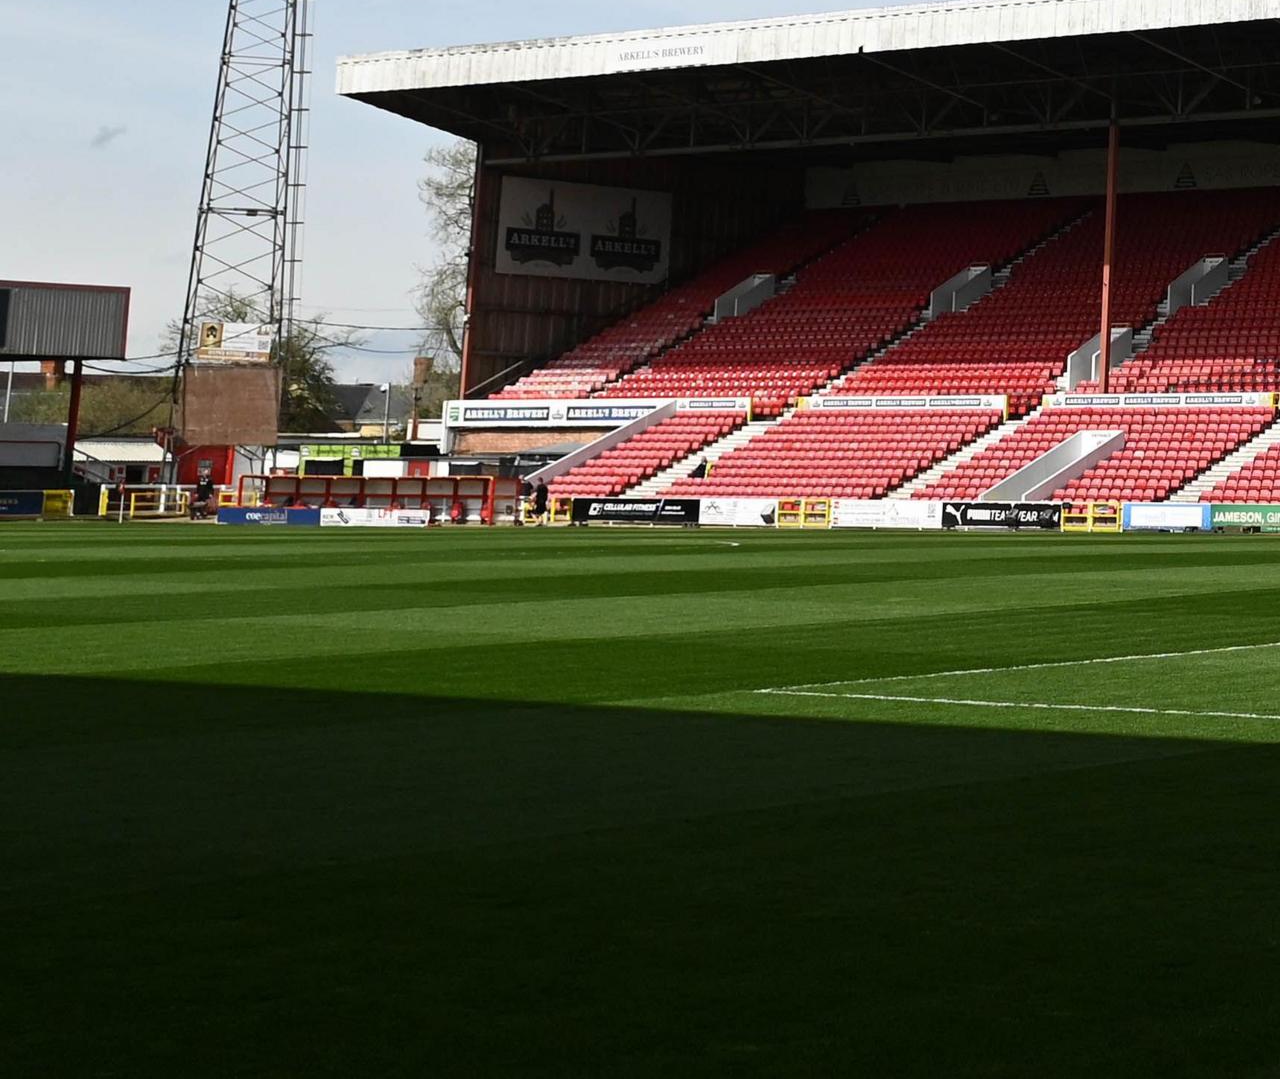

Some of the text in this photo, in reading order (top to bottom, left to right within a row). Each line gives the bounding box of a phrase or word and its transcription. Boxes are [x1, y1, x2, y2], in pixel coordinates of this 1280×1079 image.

[662, 46, 704, 58] BREWERY
[508, 231, 576, 249] ARKELL'S
[594, 239, 657, 256] ARKELL'S
[506, 408, 548, 419] BREWERY
[1214, 512, 1265, 525] JAMESON,
